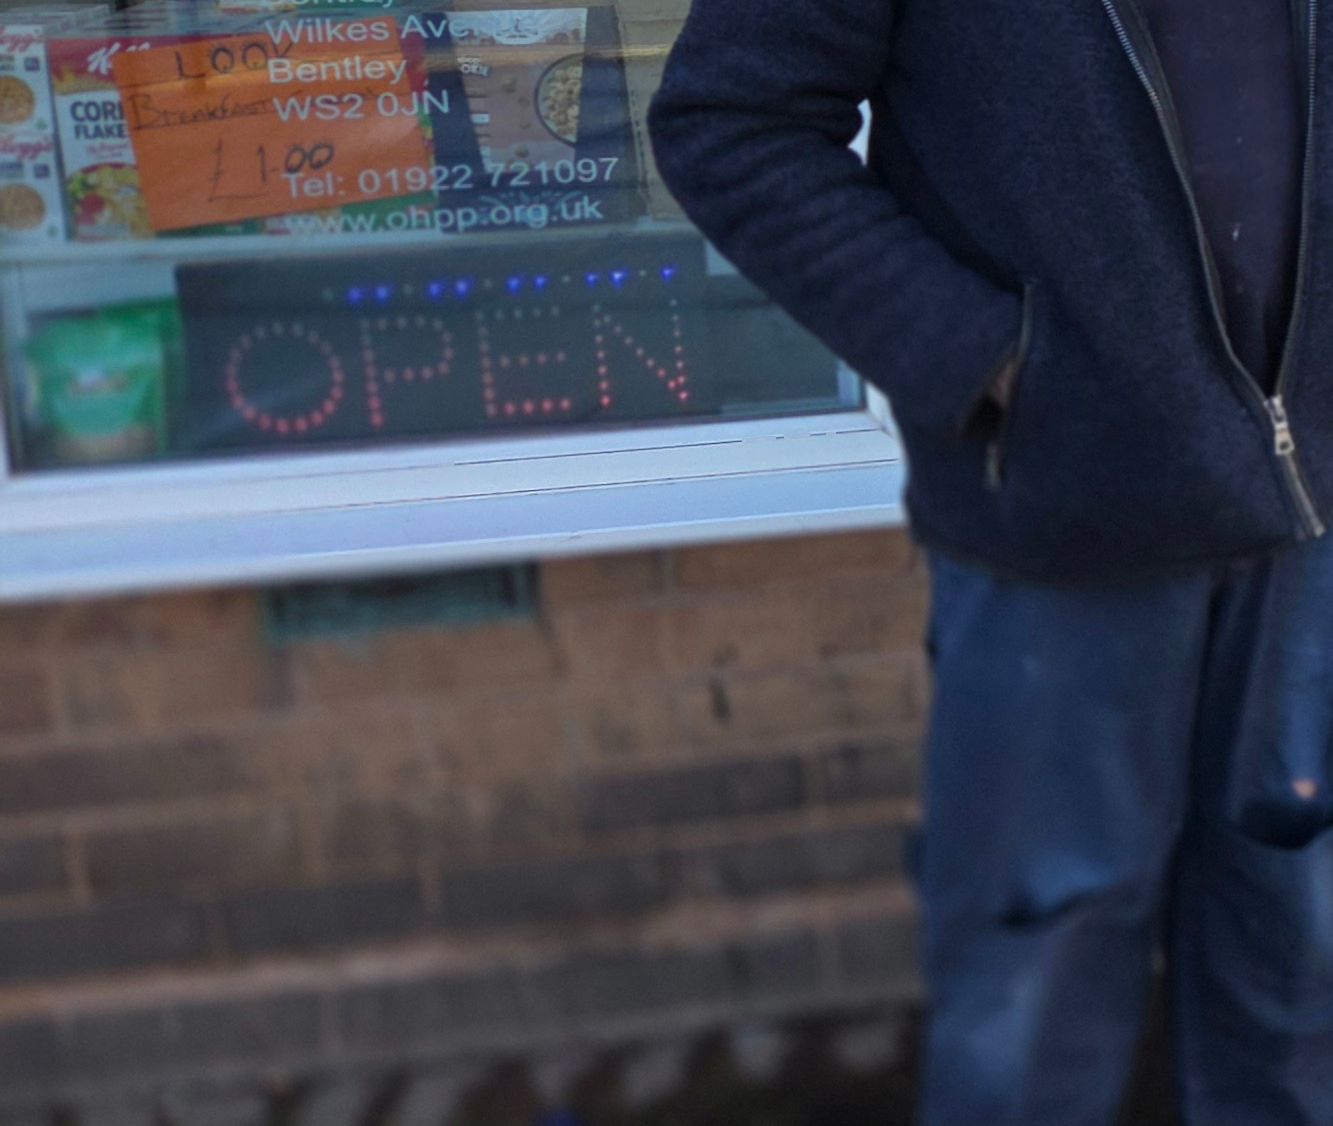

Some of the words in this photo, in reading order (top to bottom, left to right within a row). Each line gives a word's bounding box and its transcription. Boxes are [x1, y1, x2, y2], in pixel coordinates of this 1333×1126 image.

[265, 18, 390, 46] Wilkes
[267, 57, 406, 85] Bentley
[272, 93, 365, 122] WS2
[74, 123, 126, 140] FLAKE
[282, 172, 346, 198] Tel:
[358, 164, 474, 195] 01922
[489, 156, 620, 187] 721097
[286, 194, 604, 233] www.ohpp.org.uk
[226, 298, 691, 434] OPEN
